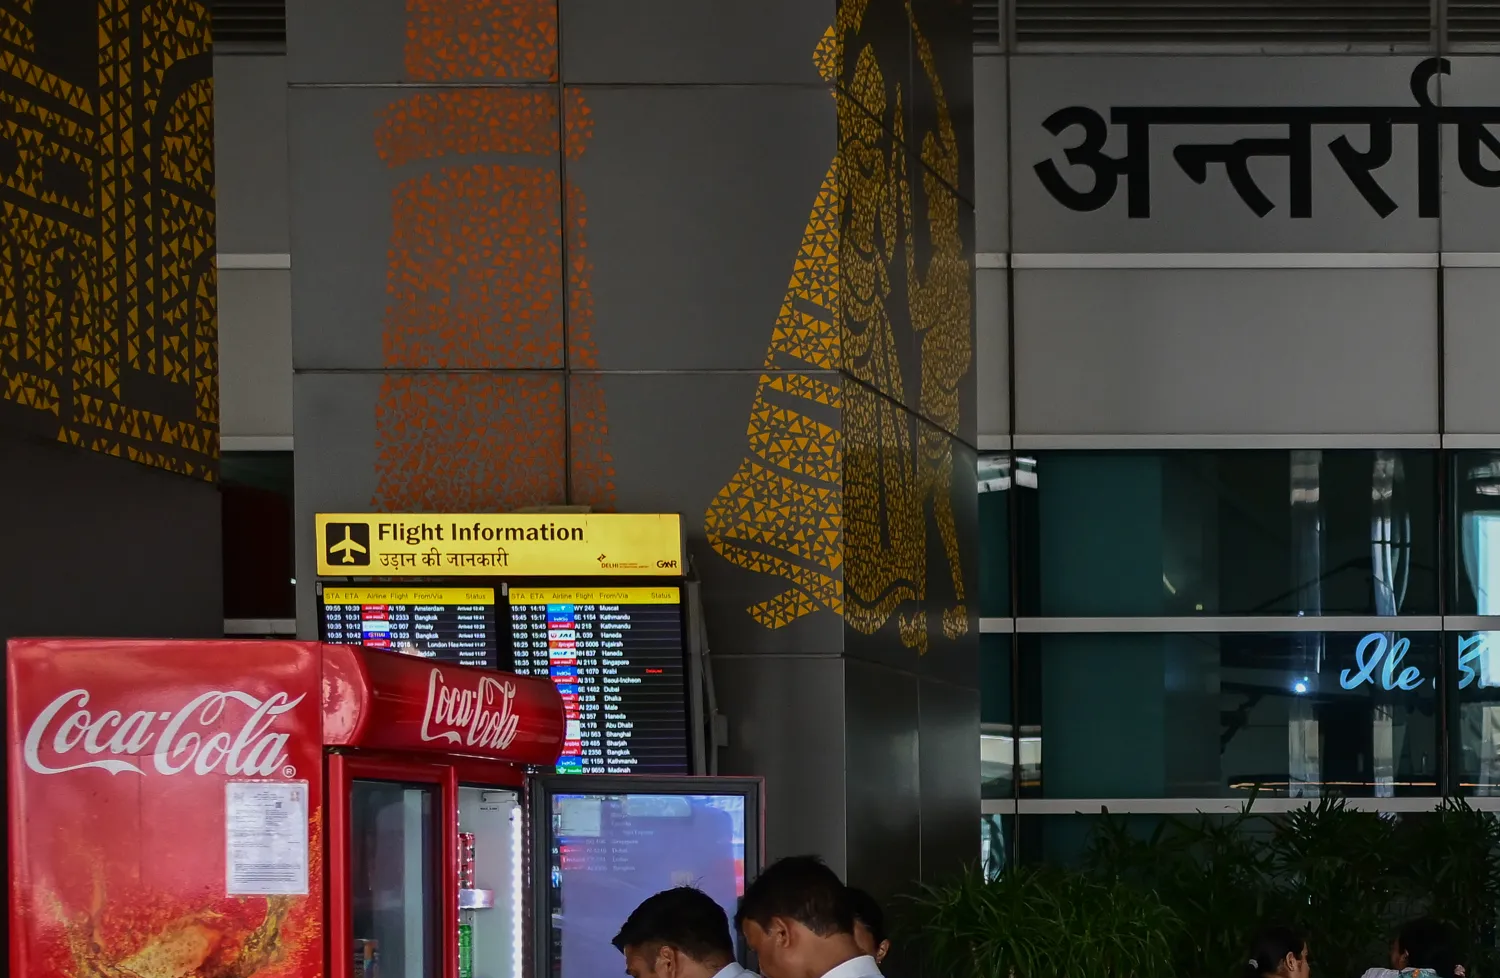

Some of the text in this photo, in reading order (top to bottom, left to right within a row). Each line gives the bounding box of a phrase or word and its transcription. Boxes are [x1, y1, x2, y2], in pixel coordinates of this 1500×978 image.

[378, 523, 583, 545] Flight Information
[379, 547, 509, 570] उड़ान की जानकारी
[415, 632, 439, 640] Bangkok
[420, 667, 520, 750] Coca-Cola
[25, 689, 306, 777] Coca-Cola
